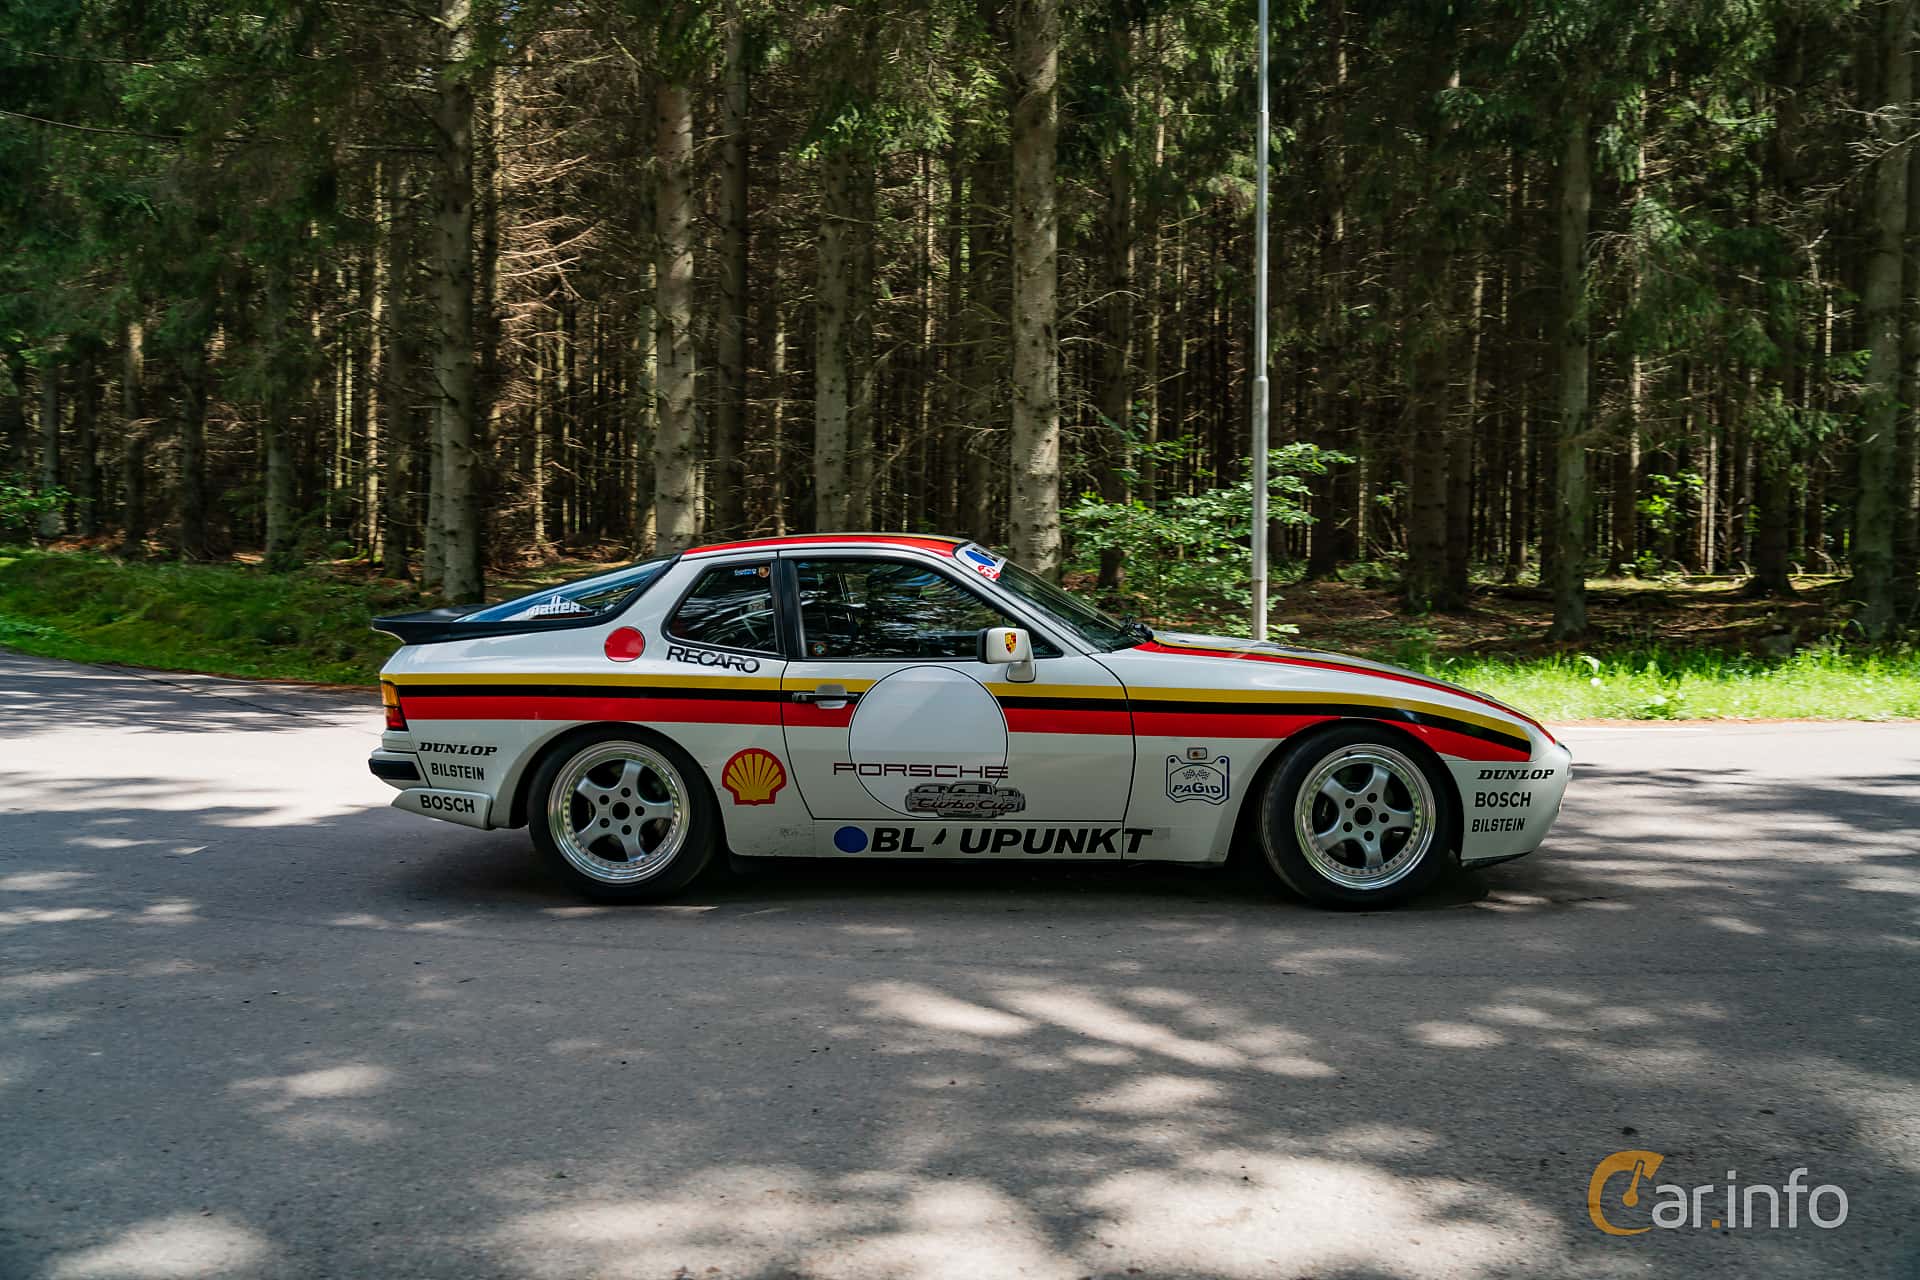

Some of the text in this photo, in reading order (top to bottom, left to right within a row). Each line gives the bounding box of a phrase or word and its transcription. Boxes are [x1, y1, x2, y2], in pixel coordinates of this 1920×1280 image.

[666, 645, 760, 673] RECARO
[419, 742, 498, 756] DUNLOP
[431, 762, 484, 780] BILSTEIN
[833, 762, 1009, 778] PORSCHE
[1477, 769, 1555, 780] DUNLOP
[1172, 782, 1221, 794] PAGID
[420, 794, 475, 813] BOSCH
[917, 798, 1015, 812] Turbo Cup
[1474, 791, 1532, 808] BOSCH
[1471, 817, 1526, 833] BILSTEIN
